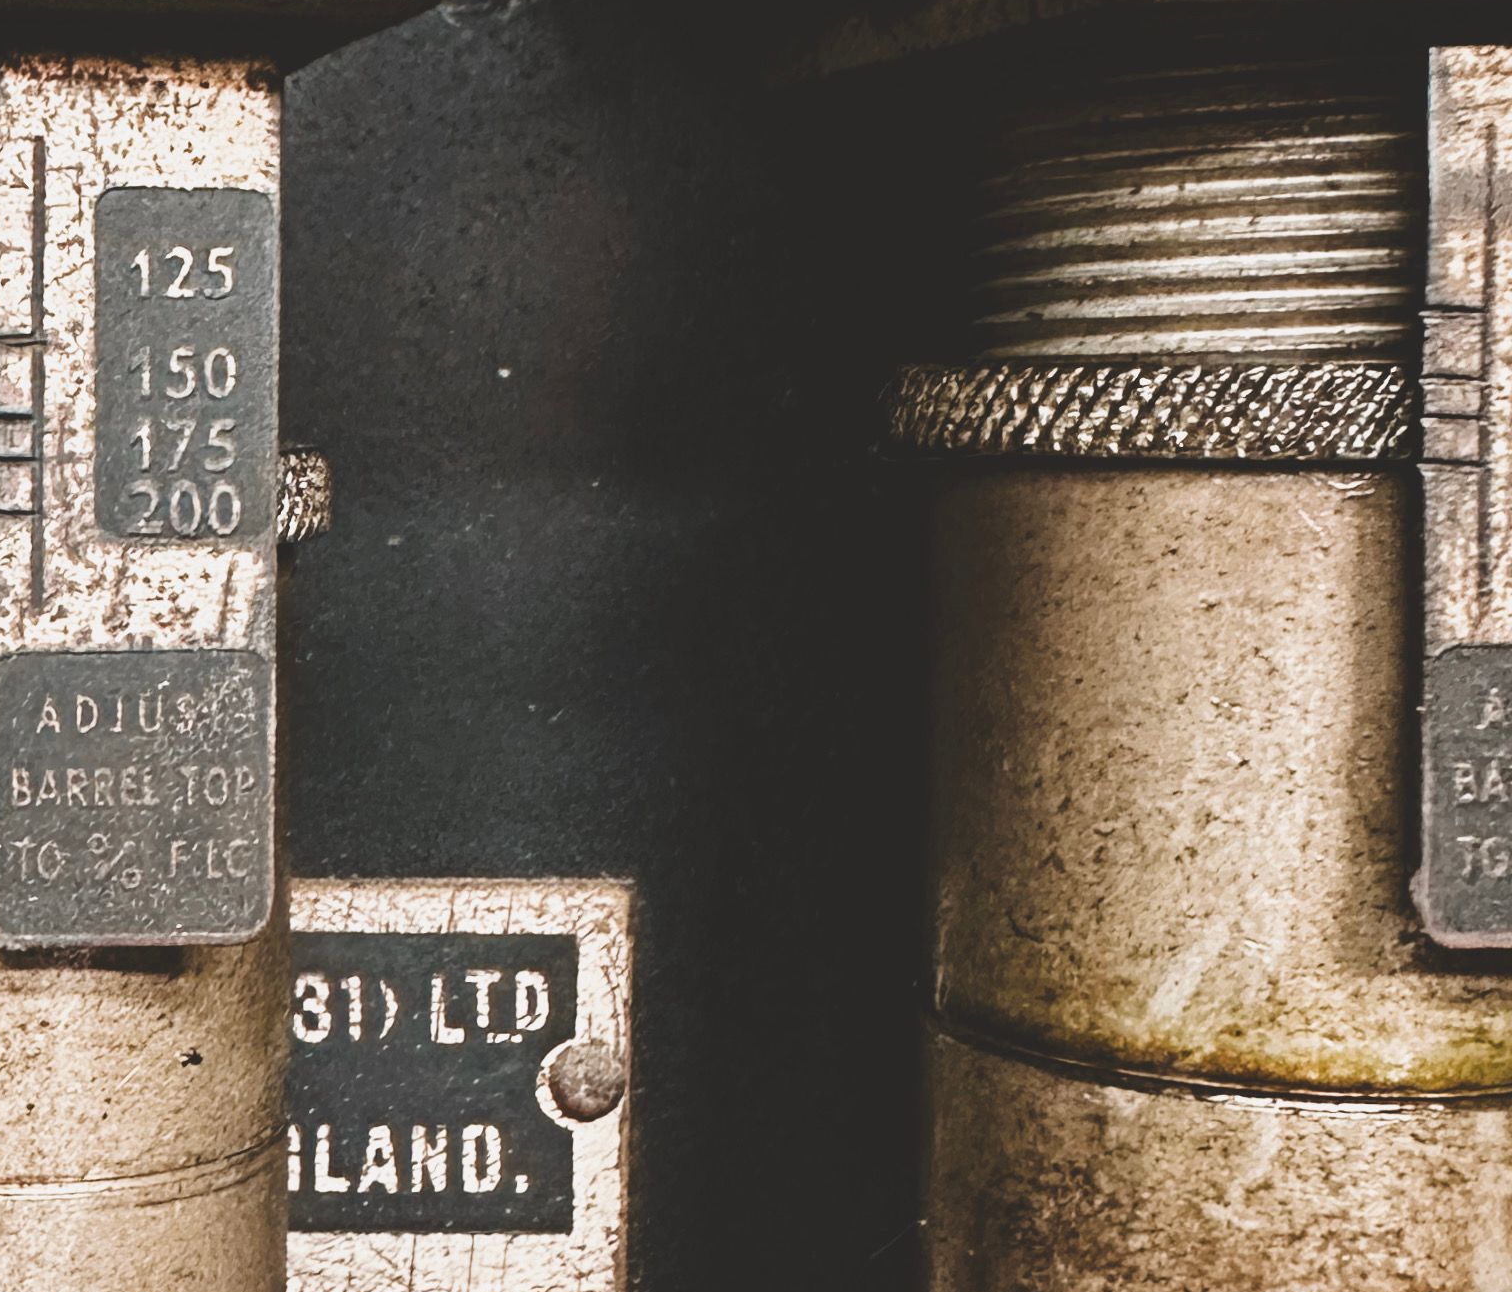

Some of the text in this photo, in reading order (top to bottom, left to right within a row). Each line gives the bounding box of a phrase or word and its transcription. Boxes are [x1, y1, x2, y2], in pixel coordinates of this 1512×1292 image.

[130, 245, 236, 299] 125
[128, 345, 238, 400] 150
[129, 417, 237, 472] 175
[128, 479, 242, 536] 200
[10, 764, 256, 808] BARREL TOP
[9, 835, 70, 884] TO
